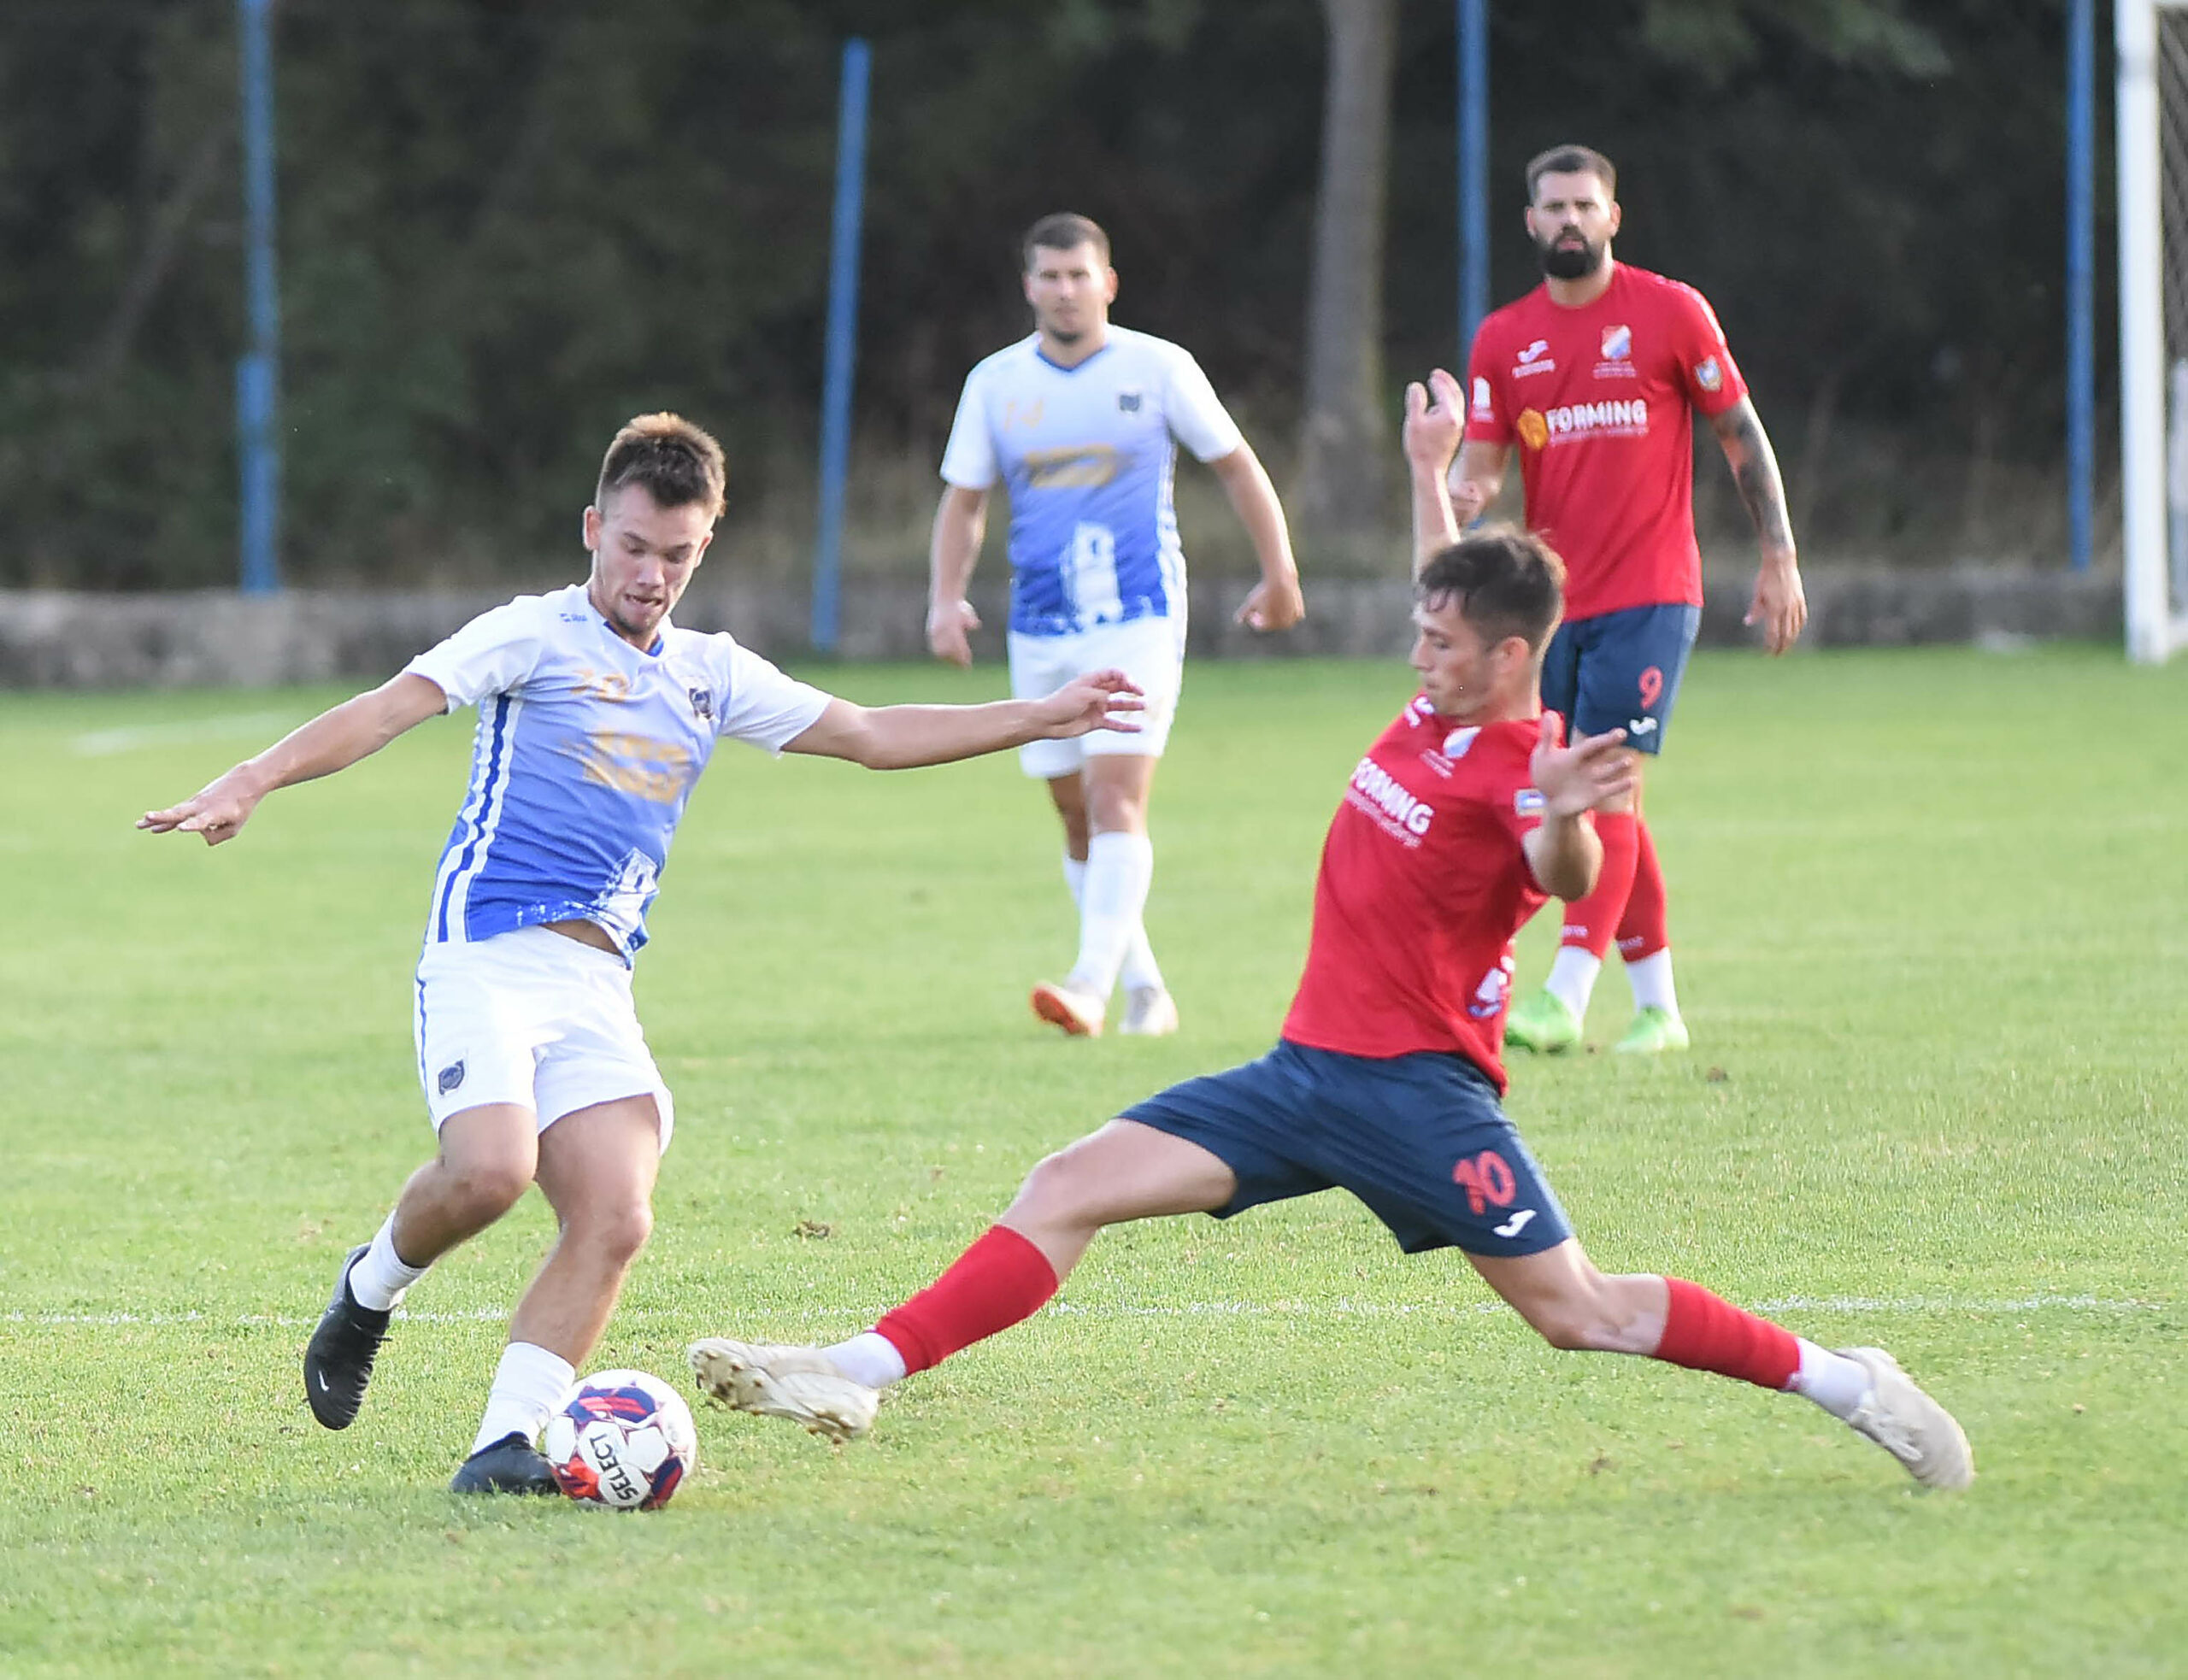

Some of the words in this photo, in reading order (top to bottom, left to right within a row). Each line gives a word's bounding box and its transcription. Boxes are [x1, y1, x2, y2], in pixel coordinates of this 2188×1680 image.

[1545, 398, 1648, 433] FORMING
[1638, 665, 1663, 710] 9
[1452, 1150, 1516, 1215] 10
[589, 1433, 639, 1501] SELECT
